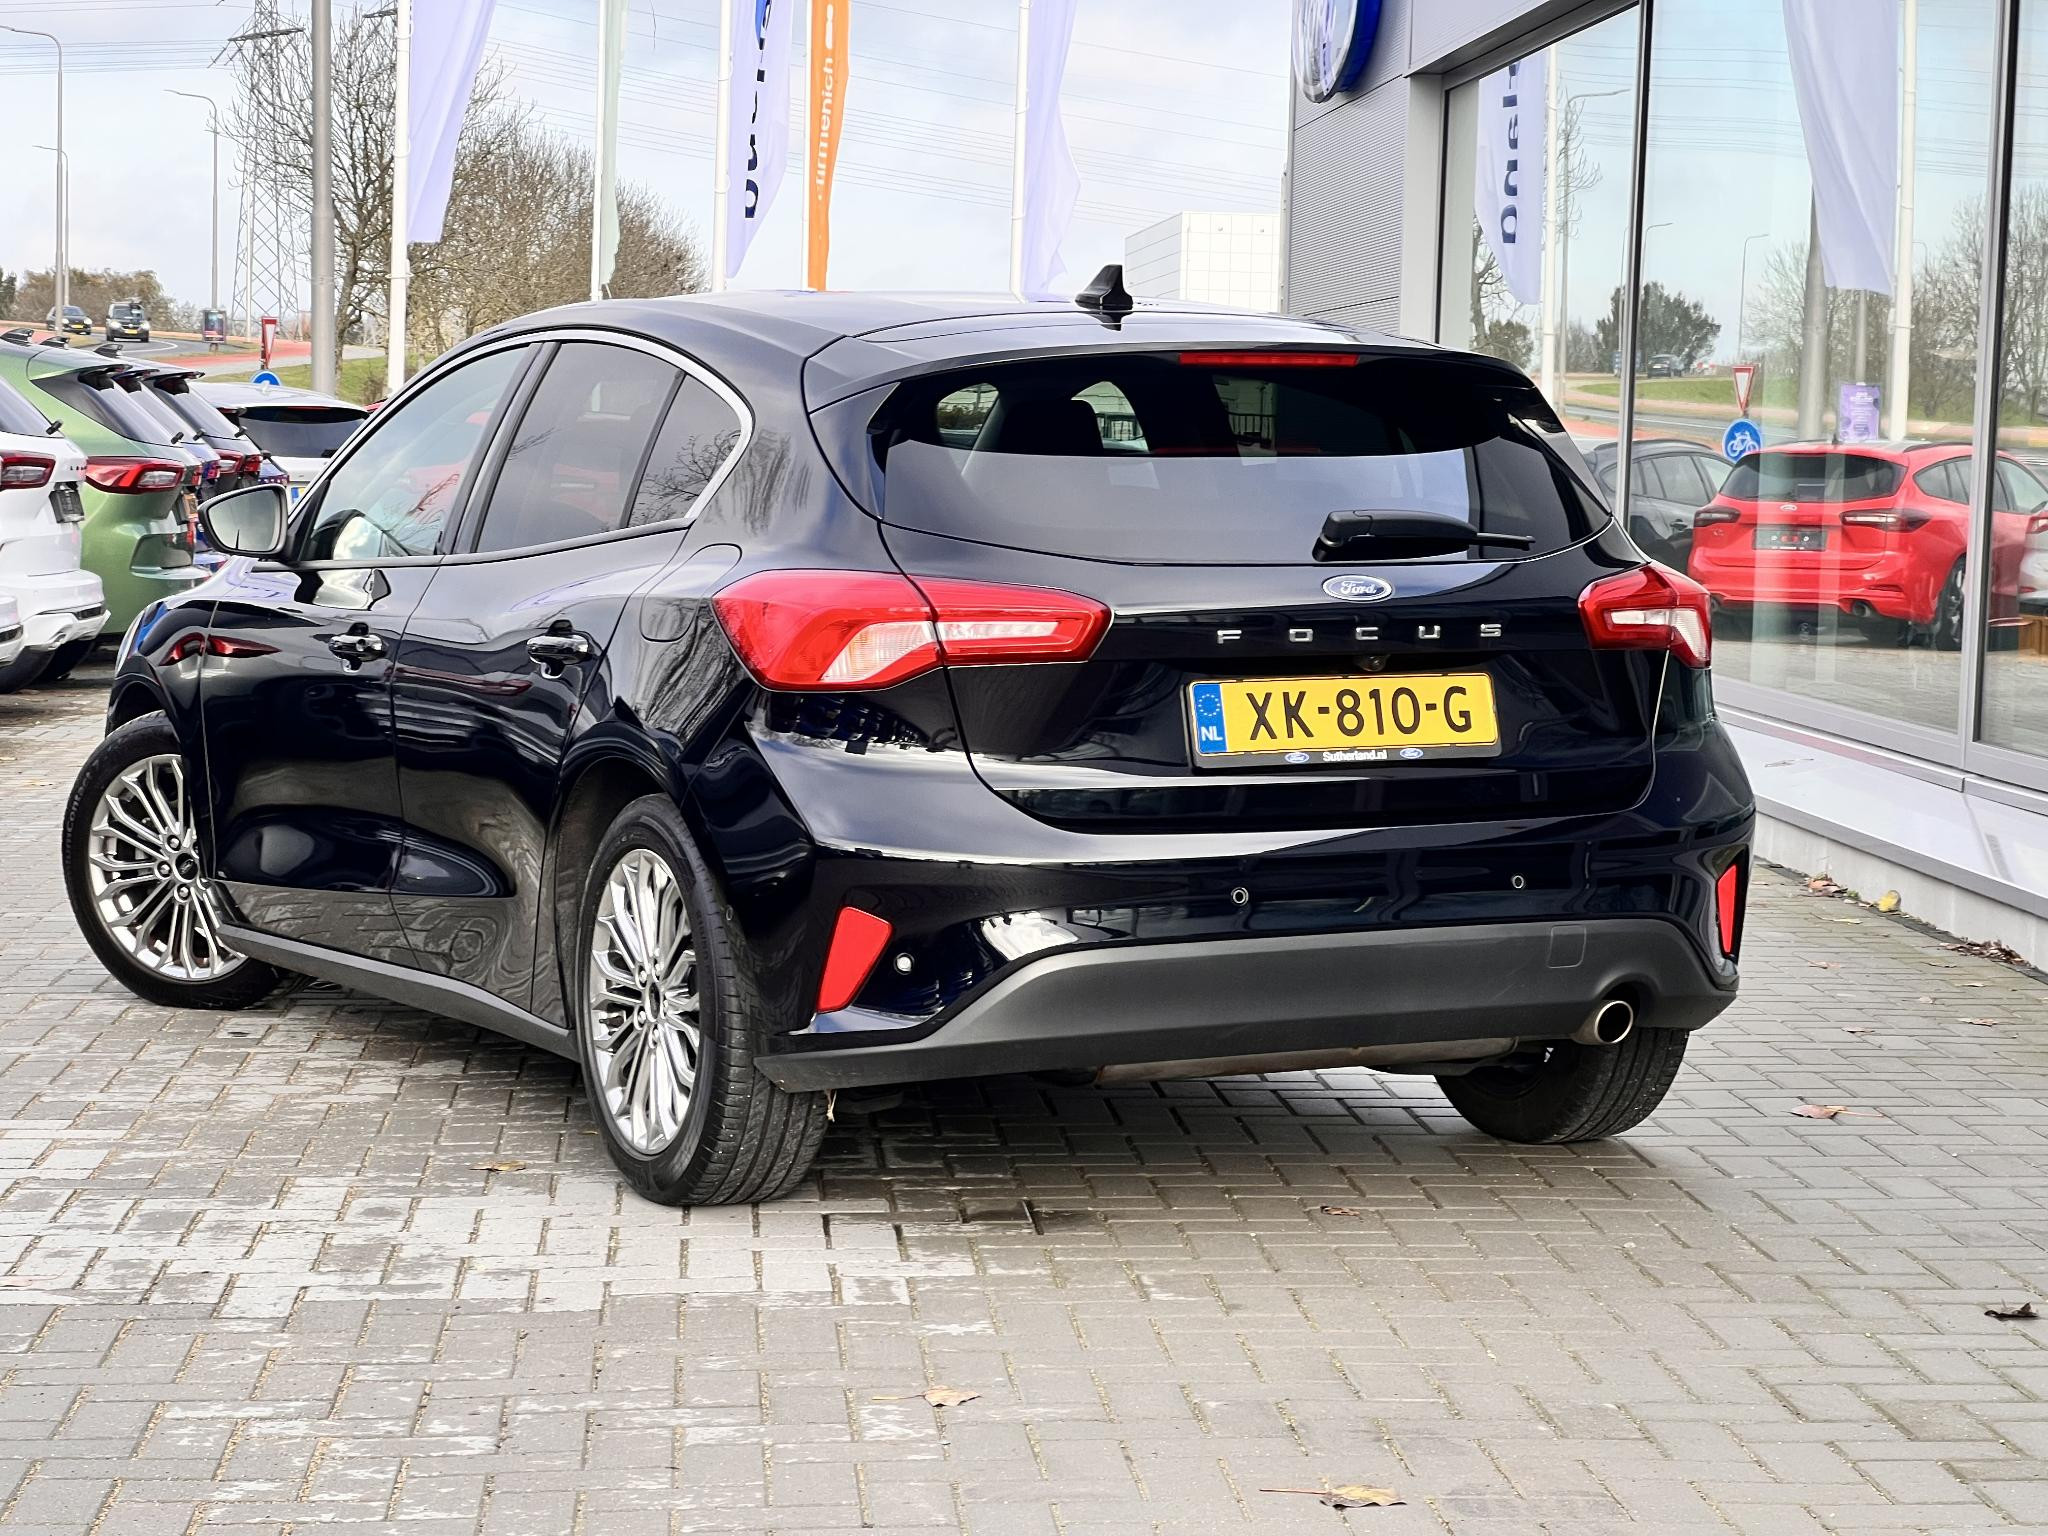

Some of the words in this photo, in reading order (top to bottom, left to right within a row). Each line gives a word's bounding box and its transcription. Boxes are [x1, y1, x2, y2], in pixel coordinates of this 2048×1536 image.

[1341, 580, 1377, 595] Ford
[1216, 623, 1502, 644] FOCUS
[1246, 685, 1473, 741] XK-810-G
[1200, 725, 1224, 742] NL
[1322, 749, 1388, 763] Sutherland.nl
